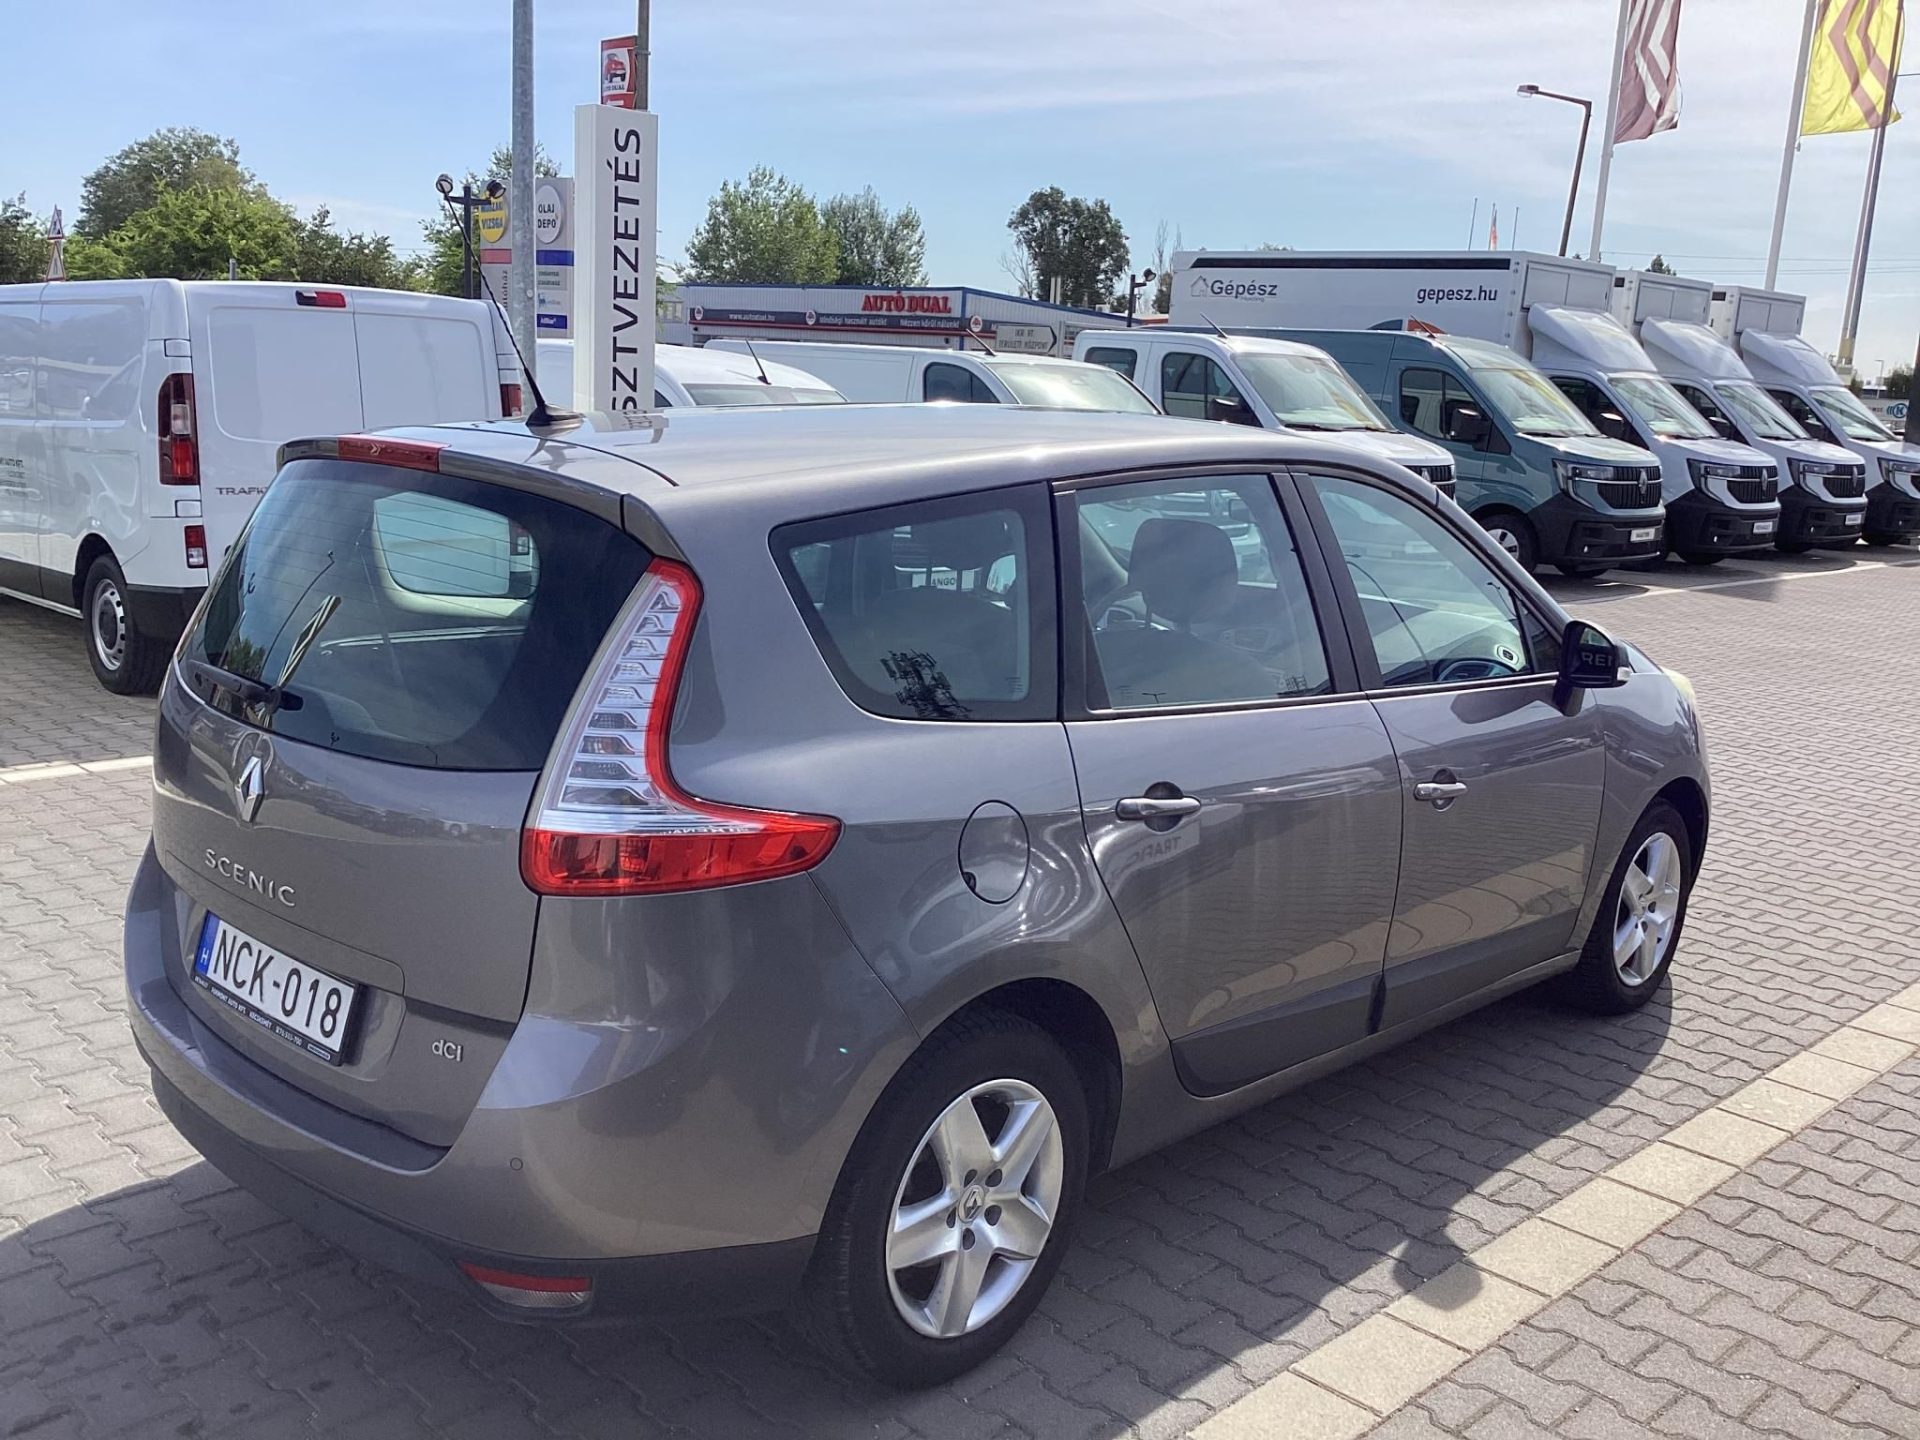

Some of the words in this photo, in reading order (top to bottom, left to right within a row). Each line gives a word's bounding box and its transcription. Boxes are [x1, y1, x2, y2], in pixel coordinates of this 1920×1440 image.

[538, 203, 555, 214] OLAJ
[481, 216, 503, 230] VIZSGA
[1210, 279, 1278, 299] Gépész
[1416, 285, 1498, 304] gepesz.hu
[861, 290, 905, 312] AUTÓ
[906, 295, 952, 314] DUAL
[204, 848, 297, 908] SCENIC
[200, 947, 209, 964] H
[213, 929, 342, 1039] NCK-018
